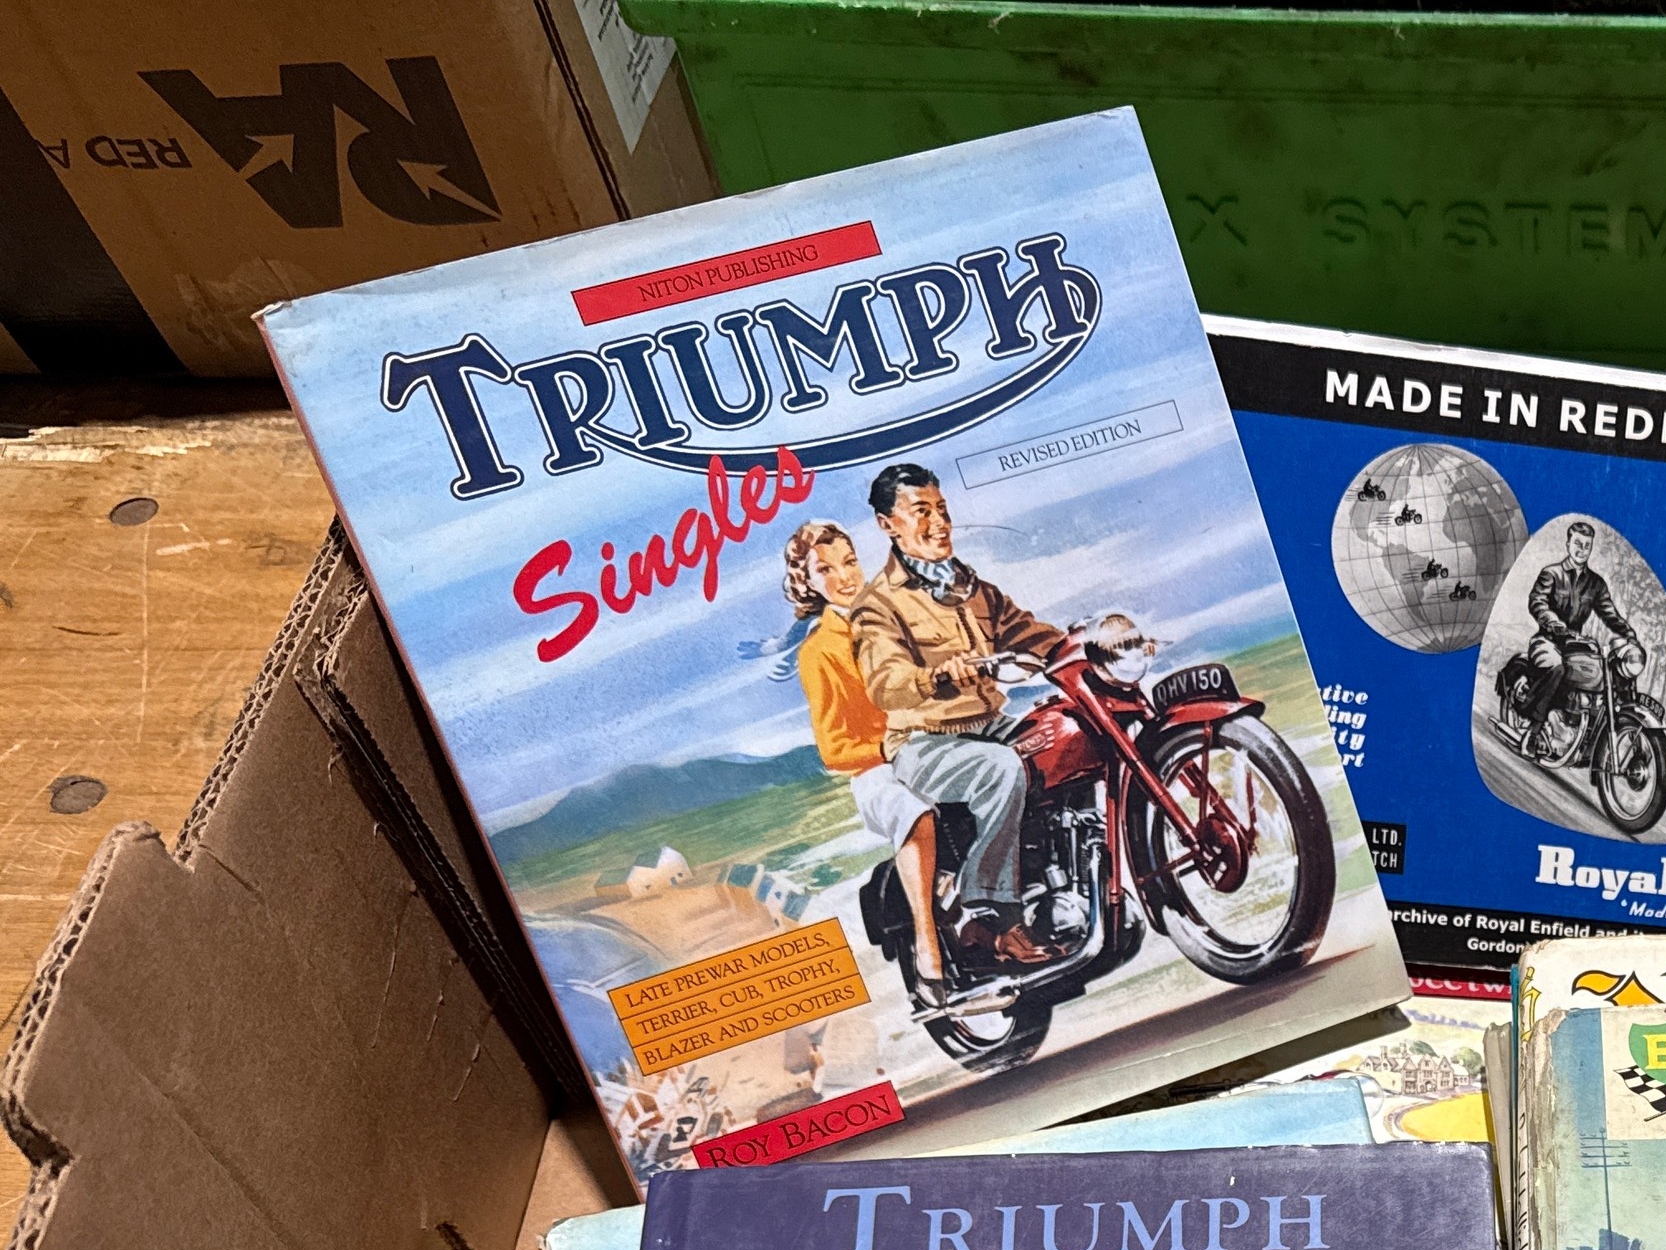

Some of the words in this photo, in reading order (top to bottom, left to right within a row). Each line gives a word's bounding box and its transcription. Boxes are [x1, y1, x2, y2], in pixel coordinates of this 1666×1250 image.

[85, 135, 192, 169] RED
[638, 270, 704, 303] NITON
[707, 243, 819, 288] PUBLISHING
[382, 233, 1102, 500] TRIUMPH
[1325, 369, 1462, 419] MADE
[1482, 389, 1539, 428] IN
[998, 434, 1067, 474] REVISED
[1071, 419, 1143, 458] EDITION
[513, 446, 814, 664] Singles
[1191, 668, 1222, 690] 150
[1319, 684, 1368, 705] tive
[1343, 753, 1365, 767] rt
[1372, 828, 1402, 846] LTD.
[1372, 851, 1398, 868] TCH
[1453, 914, 1472, 928] of
[1476, 916, 1525, 933] Royal
[1530, 921, 1590, 938] Enfield
[1467, 937, 1525, 954] Gordon
[625, 981, 672, 1009] LATE
[676, 957, 749, 993] PREWAR
[751, 932, 830, 969] MODELS,
[636, 1001, 718, 1037] TERRIER,
[719, 985, 763, 1011] CUB,
[765, 960, 840, 993] TROPHY,
[643, 1031, 715, 1067] BLAZER
[719, 1016, 759, 1040] AND
[764, 985, 856, 1023] SCOOTERS
[706, 1133, 773, 1168] ROY
[781, 1094, 892, 1149] BACON
